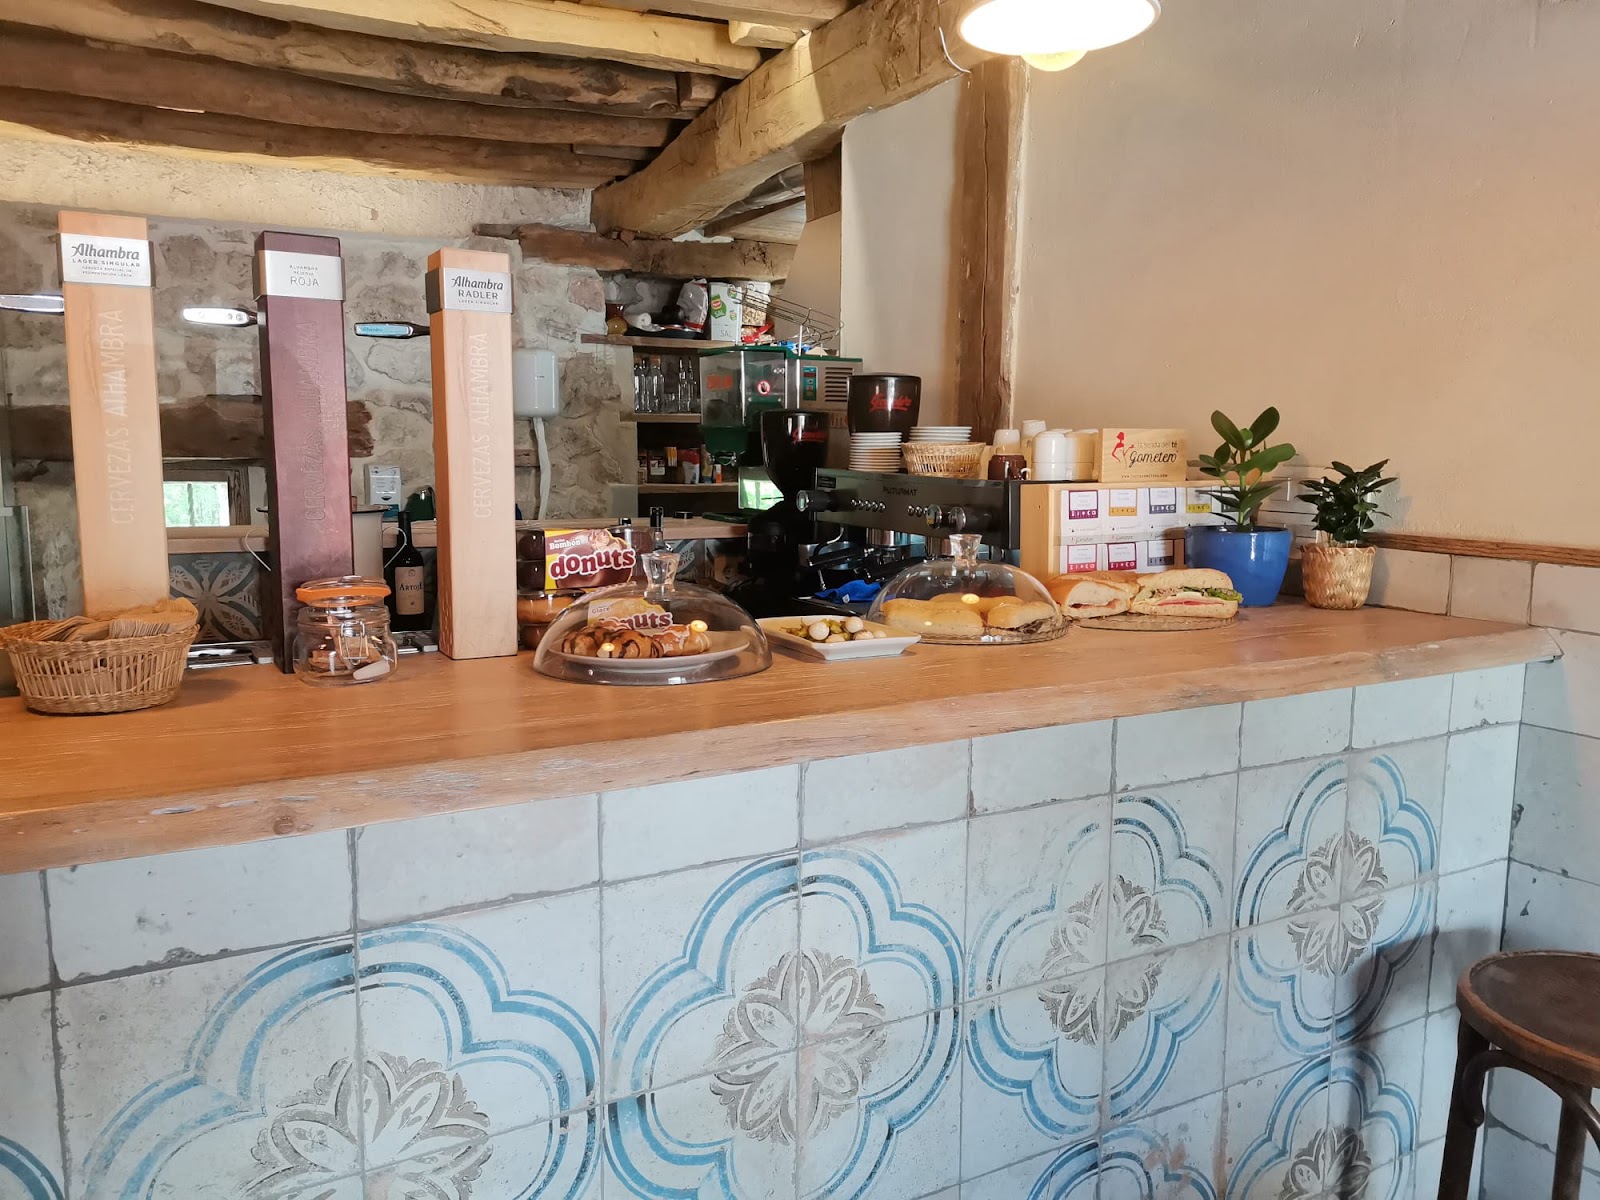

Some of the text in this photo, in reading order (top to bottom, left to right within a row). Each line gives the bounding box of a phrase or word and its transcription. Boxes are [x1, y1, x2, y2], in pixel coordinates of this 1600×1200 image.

[71, 243, 140, 260] Alhambra
[290, 276, 320, 287] ROJA
[451, 275, 504, 291] Alhambra
[458, 289, 499, 300] RADLER
[720, 329, 733, 338] SAL
[99, 309, 135, 526] CERVEZAS ALHAMBRA
[469, 332, 493, 520] CERVEZAS ALHAMBRA
[303, 429, 326, 522] CERVEZAS
[549, 539, 581, 550] Bombón
[549, 549, 636, 580] donuts
[591, 605, 611, 614] Glacé
